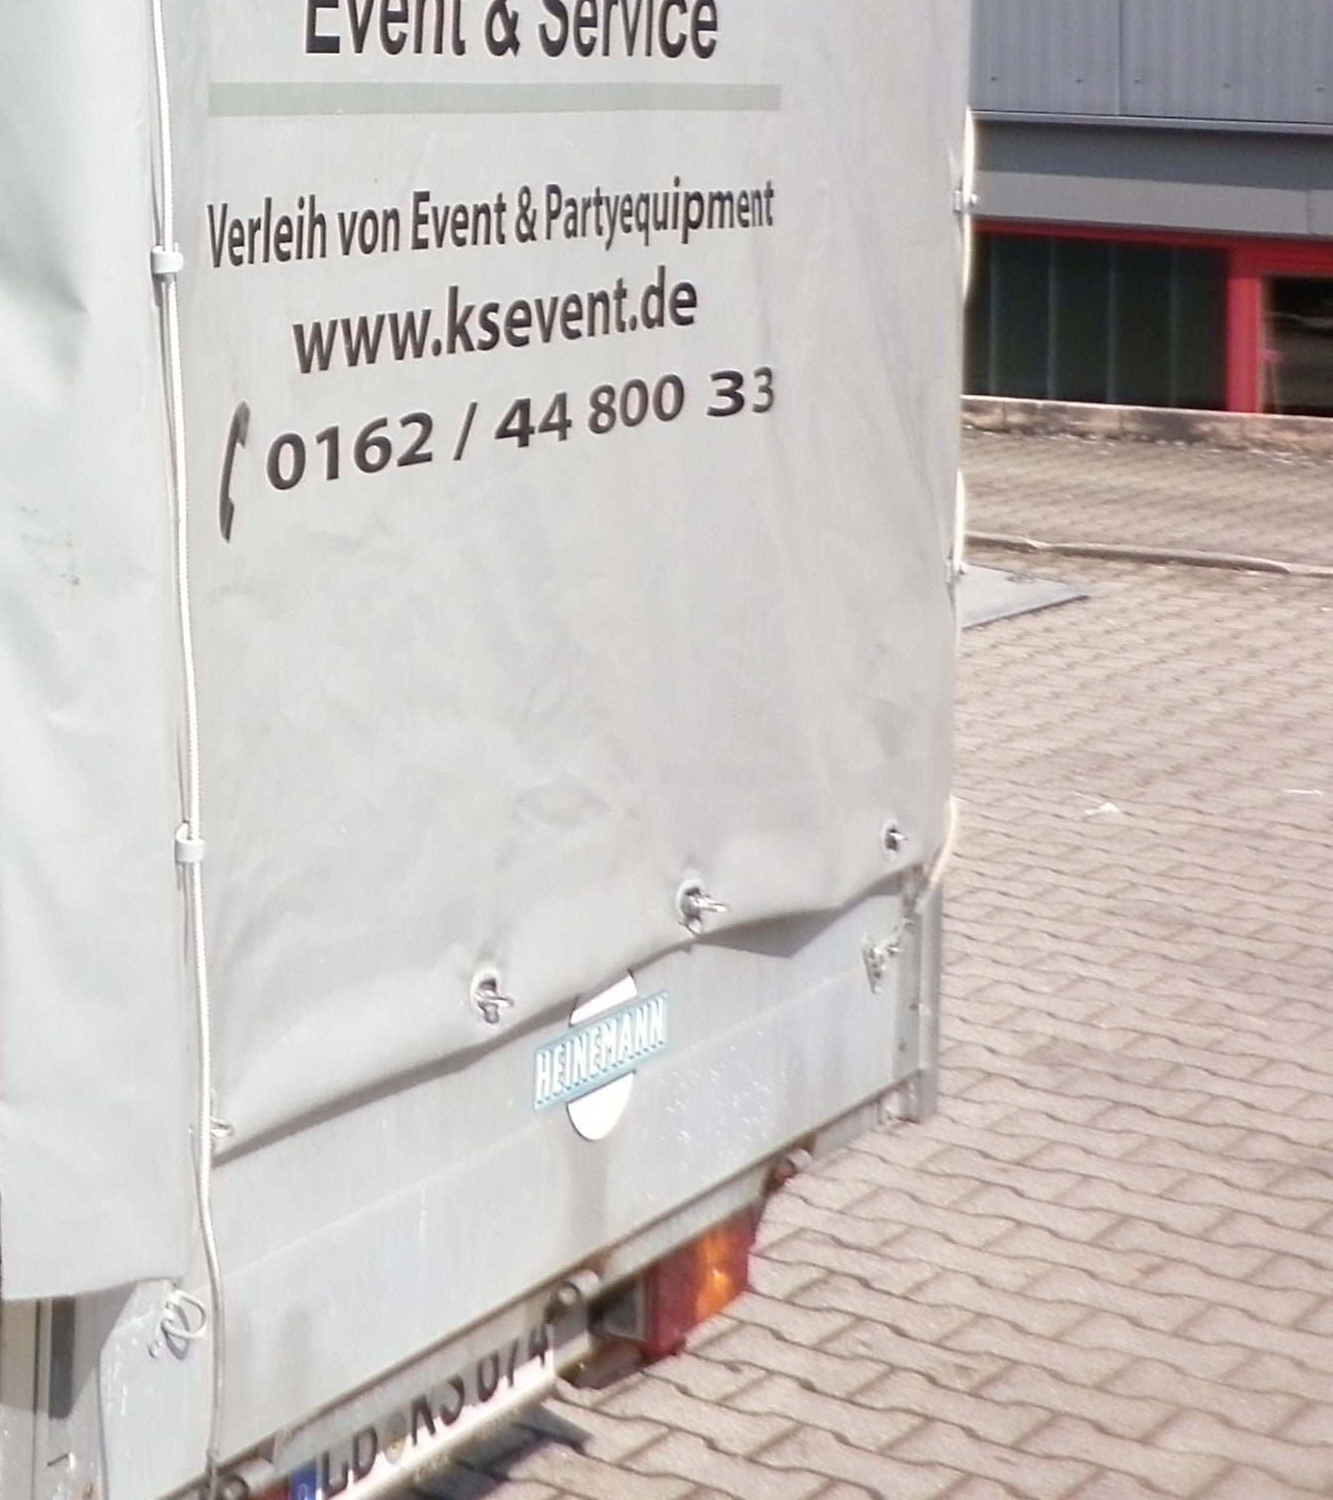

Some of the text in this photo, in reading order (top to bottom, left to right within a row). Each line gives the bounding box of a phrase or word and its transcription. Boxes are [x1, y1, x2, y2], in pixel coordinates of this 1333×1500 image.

[207, 176, 775, 269] Verleih von Event & Partyequipment
[292, 264, 698, 374] www.ksevent.de
[267, 366, 775, 491] 0162 / 44 800 33
[535, 996, 665, 1103] HEINEMANN
